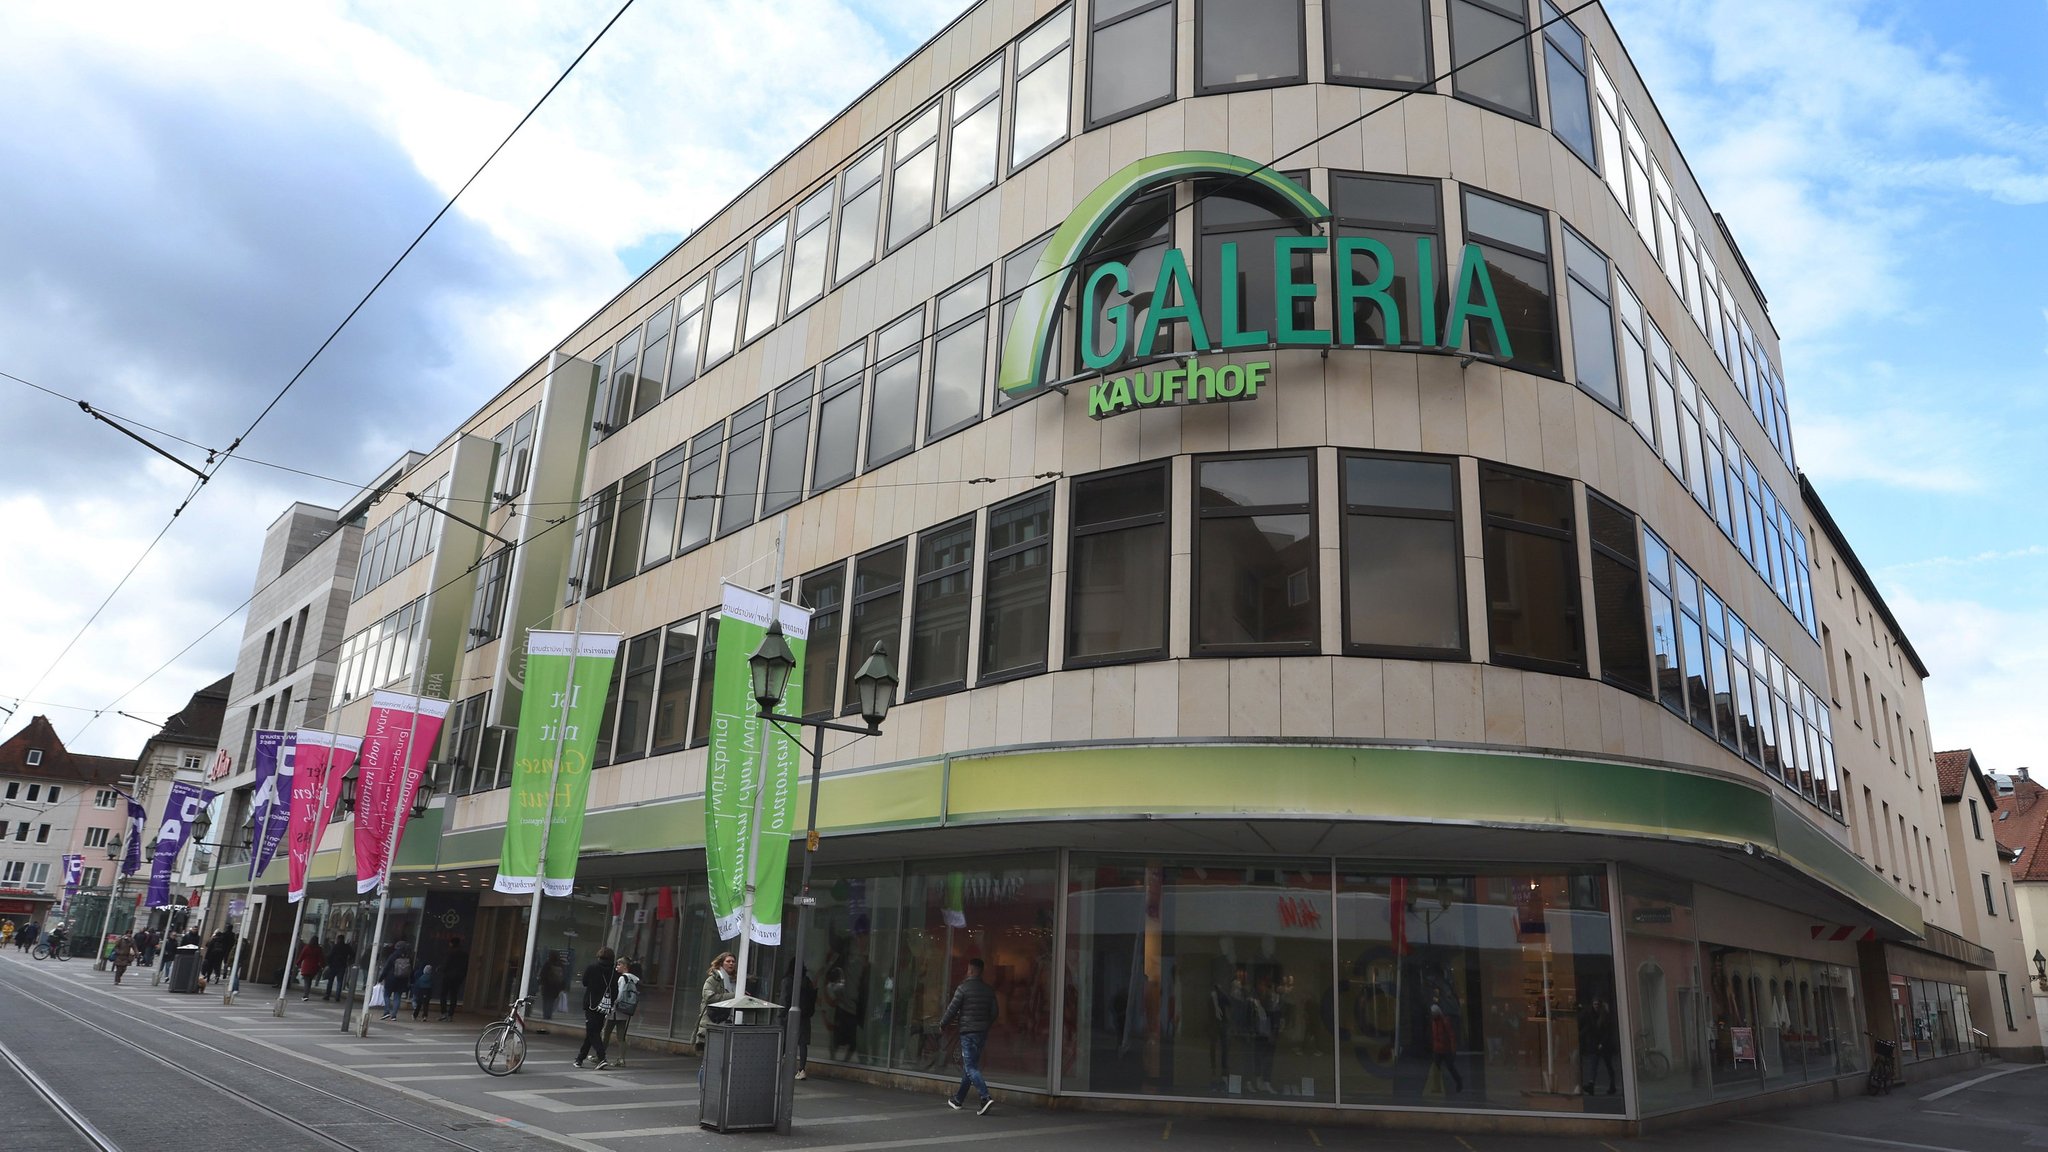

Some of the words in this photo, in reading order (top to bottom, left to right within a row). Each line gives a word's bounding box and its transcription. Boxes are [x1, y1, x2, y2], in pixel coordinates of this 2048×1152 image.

[1081, 236, 1514, 371] GALERIA
[368, 739, 382, 767] chor
[389, 731, 409, 782] würzburg
